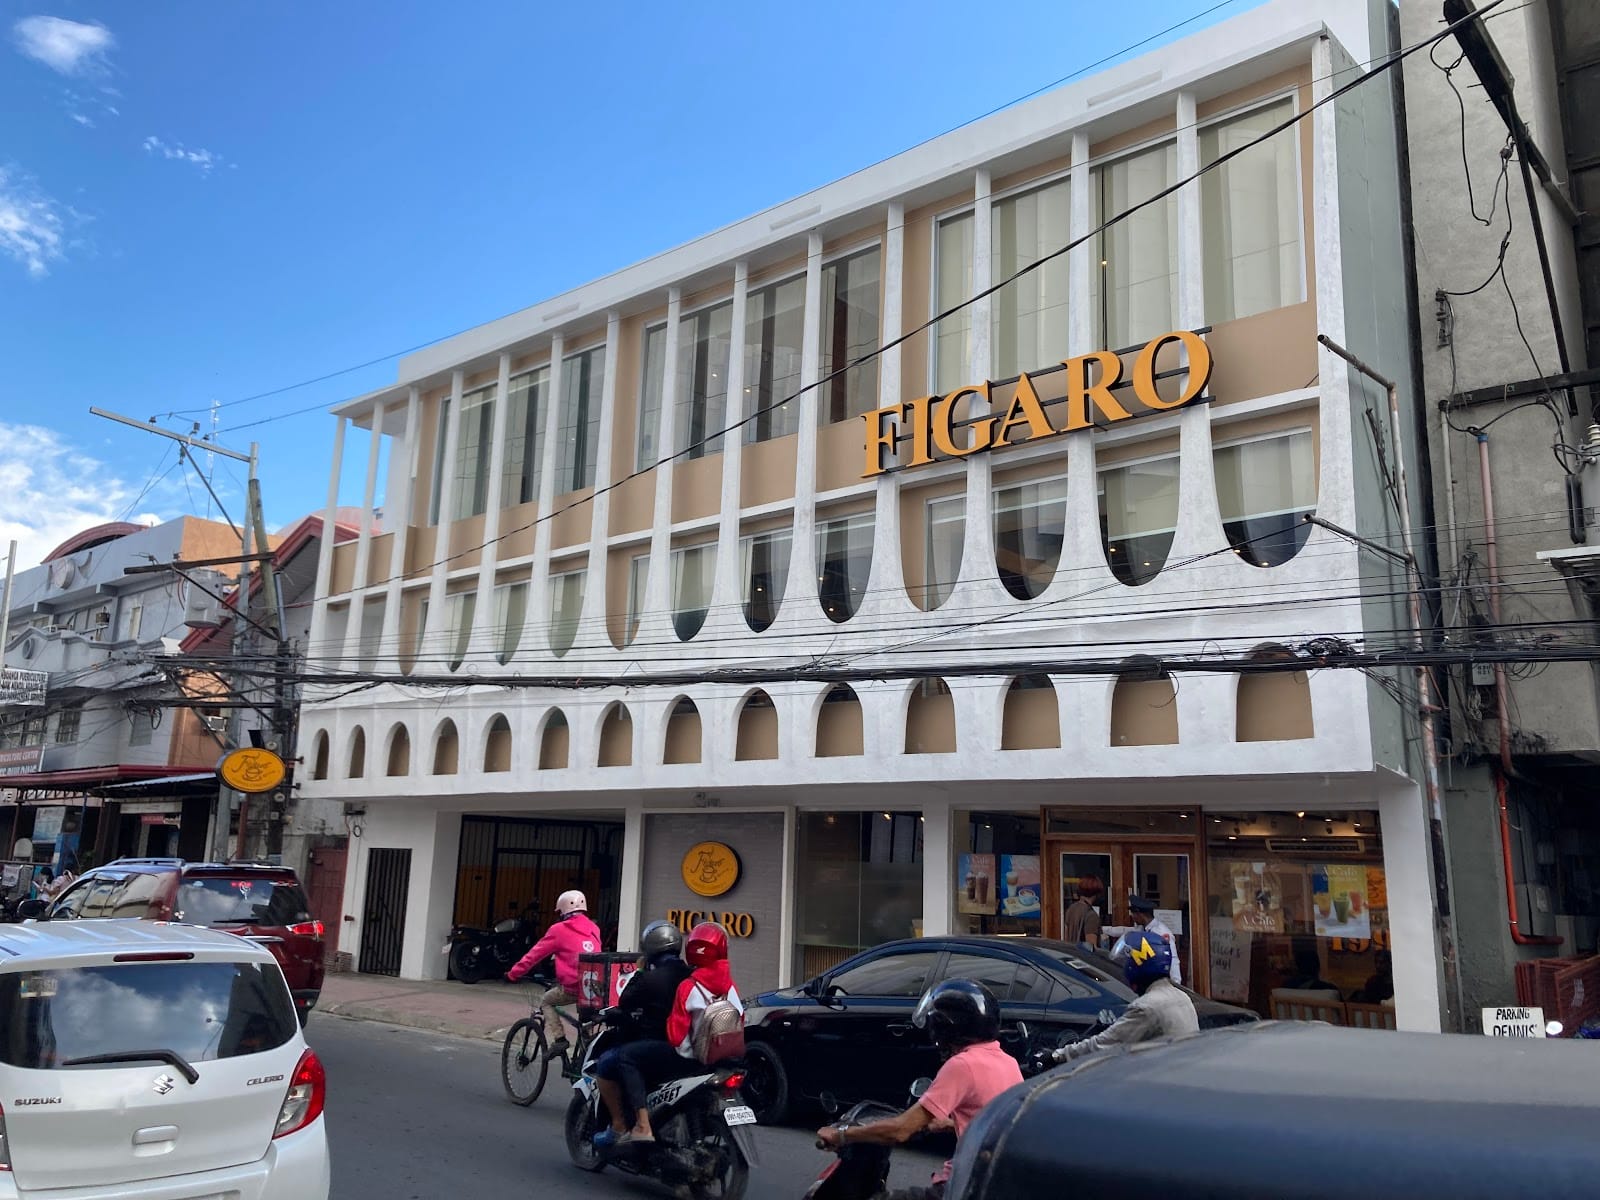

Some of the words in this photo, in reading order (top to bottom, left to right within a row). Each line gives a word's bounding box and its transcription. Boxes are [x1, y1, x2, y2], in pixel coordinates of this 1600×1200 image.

[861, 331, 1212, 478] FIGARO
[1496, 1008, 1530, 1020] PARKING
[246, 1074, 284, 1086] CELERIO
[14, 1097, 62, 1107] SUZUKI
